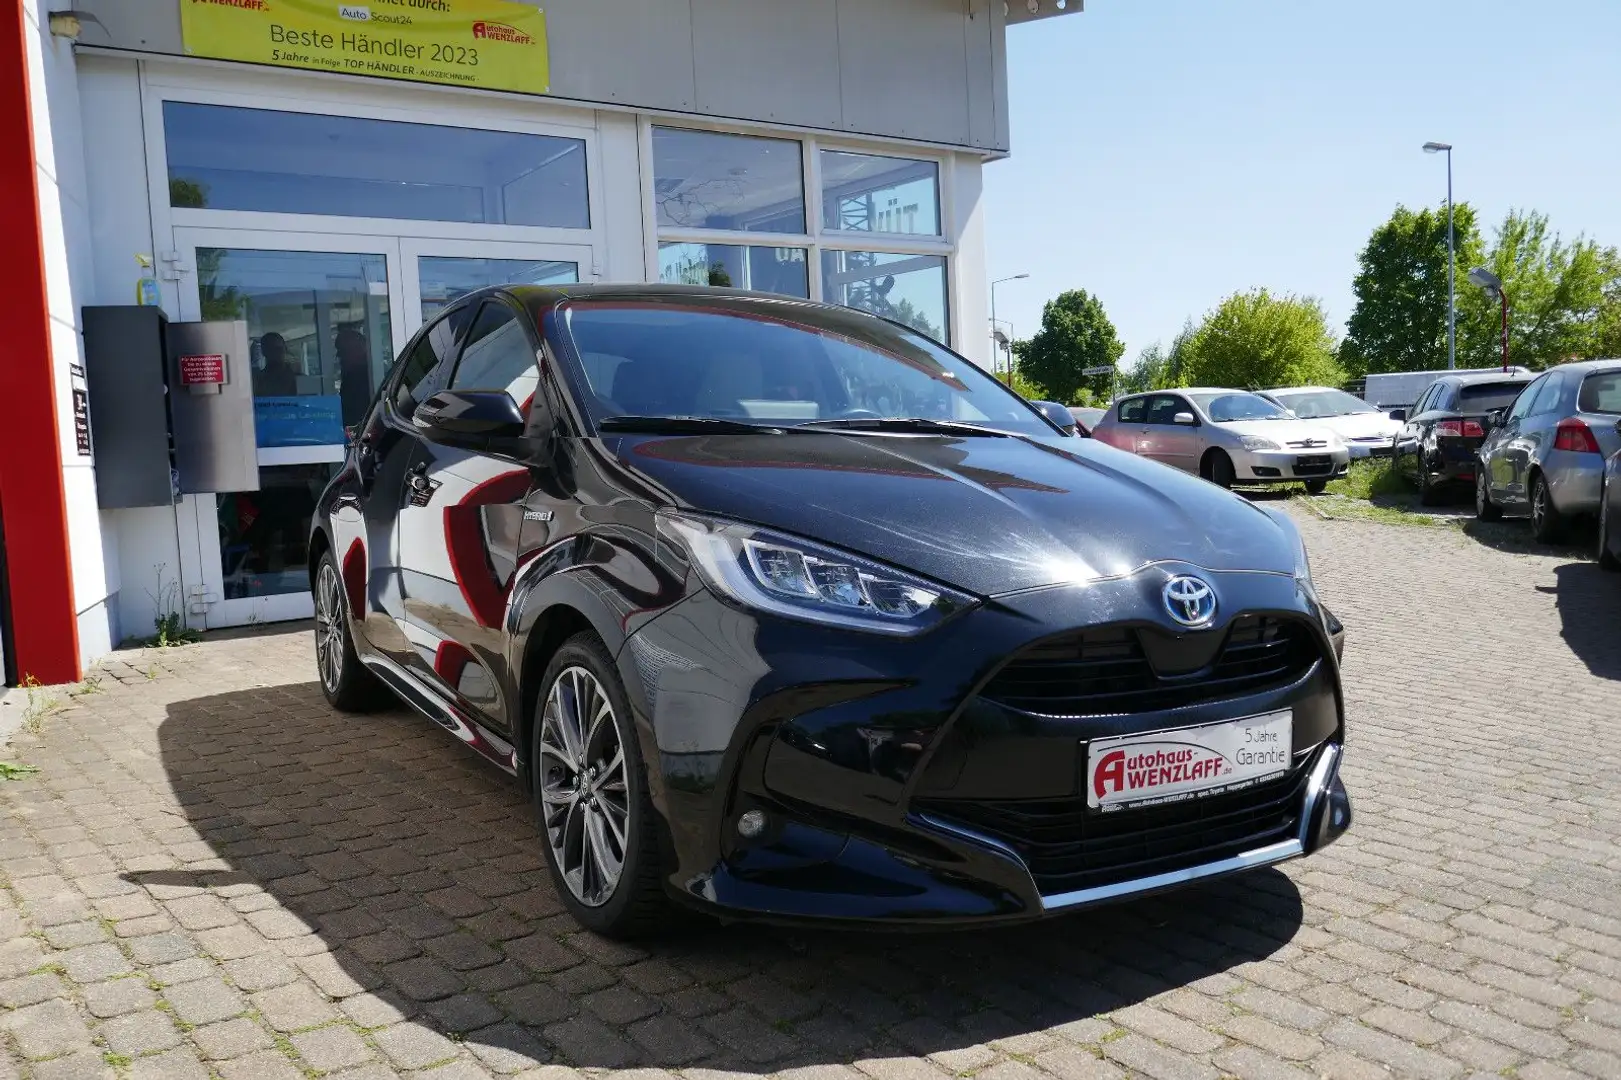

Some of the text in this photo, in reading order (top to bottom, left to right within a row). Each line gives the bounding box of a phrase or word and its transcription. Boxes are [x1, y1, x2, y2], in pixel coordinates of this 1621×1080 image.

[341, 8, 413, 25] Auto Scout24
[271, 24, 479, 66] Beste Händler 2023
[272, 49, 280, 61] 5
[281, 51, 309, 63] Jahre
[321, 57, 341, 67] Folge
[344, 58, 364, 69] TOP
[366, 60, 415, 75] HÄNDLER
[1245, 728, 1278, 743] 5 Jahre
[1236, 746, 1285, 766] Garantie
